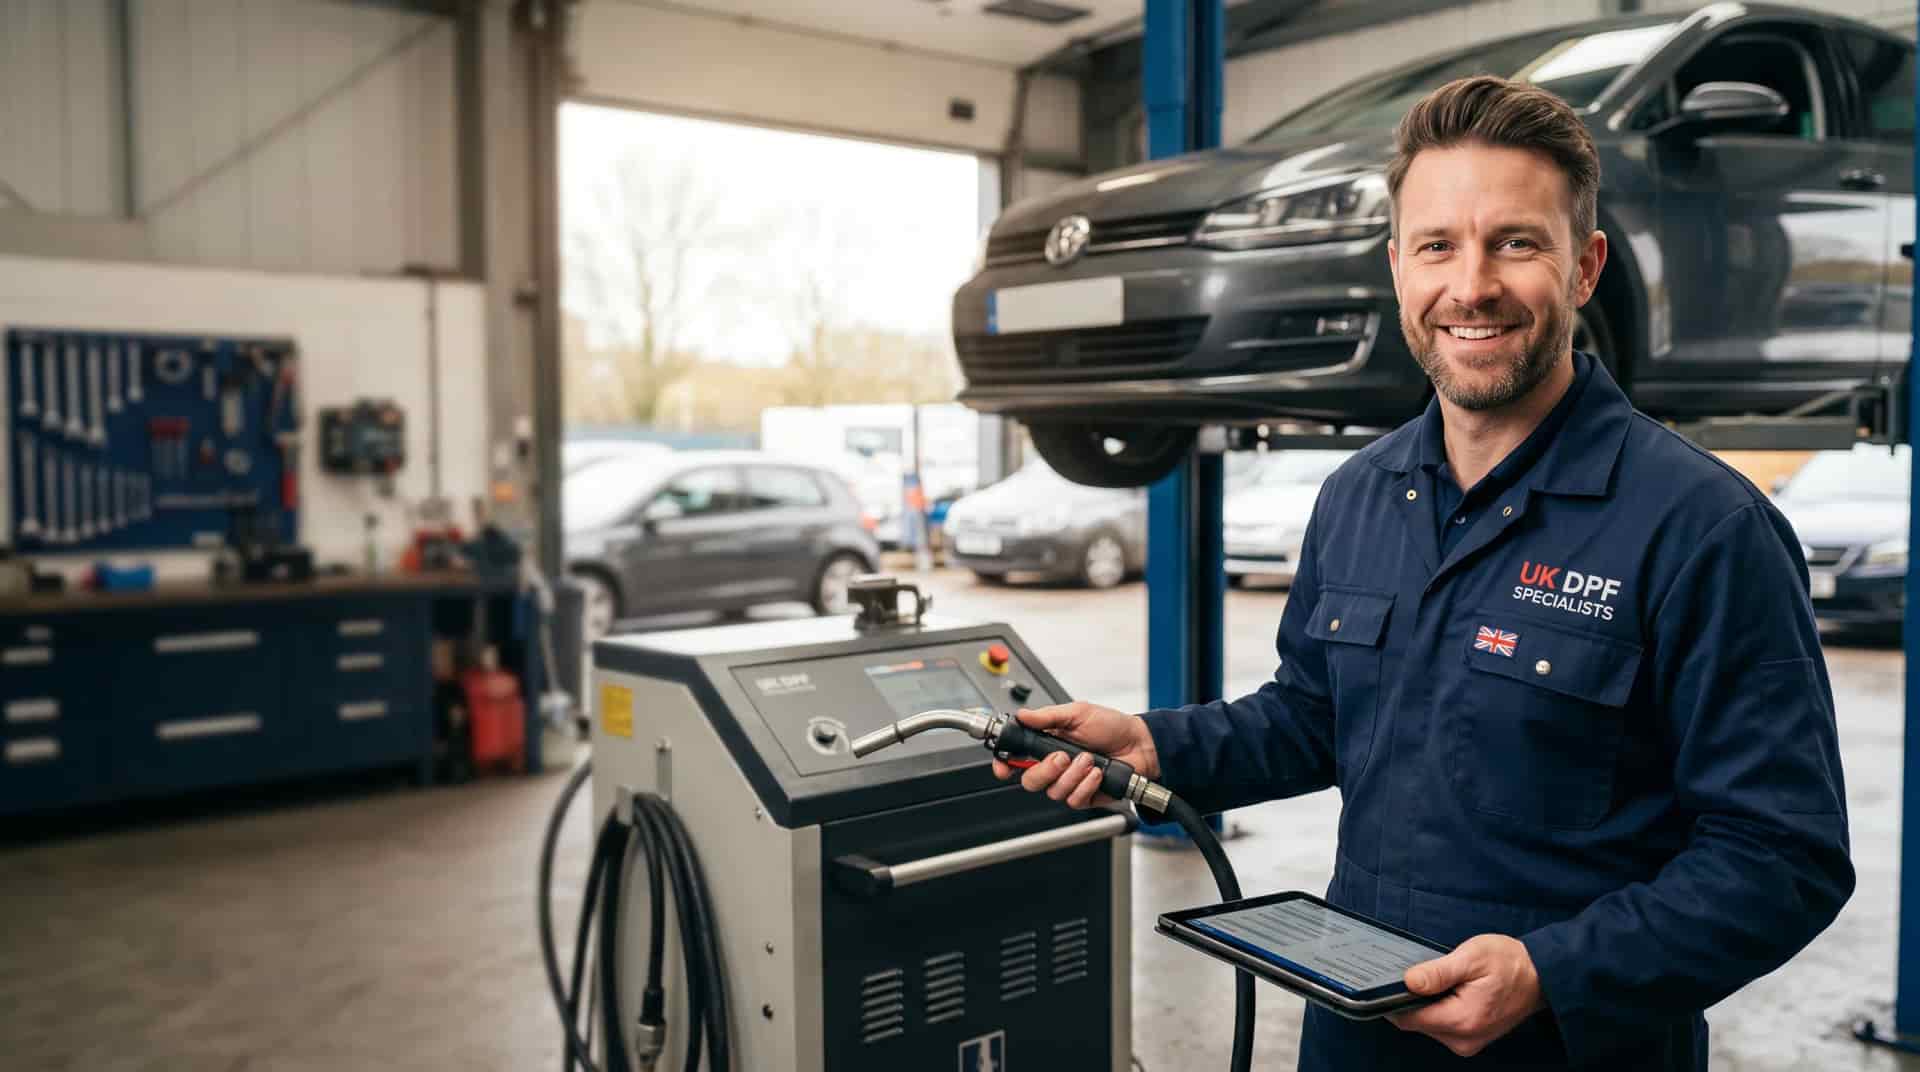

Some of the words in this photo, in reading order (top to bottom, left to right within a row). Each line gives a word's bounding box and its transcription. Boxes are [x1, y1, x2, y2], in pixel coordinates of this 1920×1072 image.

[1519, 561, 1561, 589] UK
[1562, 570, 1622, 601] DPF
[1512, 586, 1615, 621] SPECIALISTS
